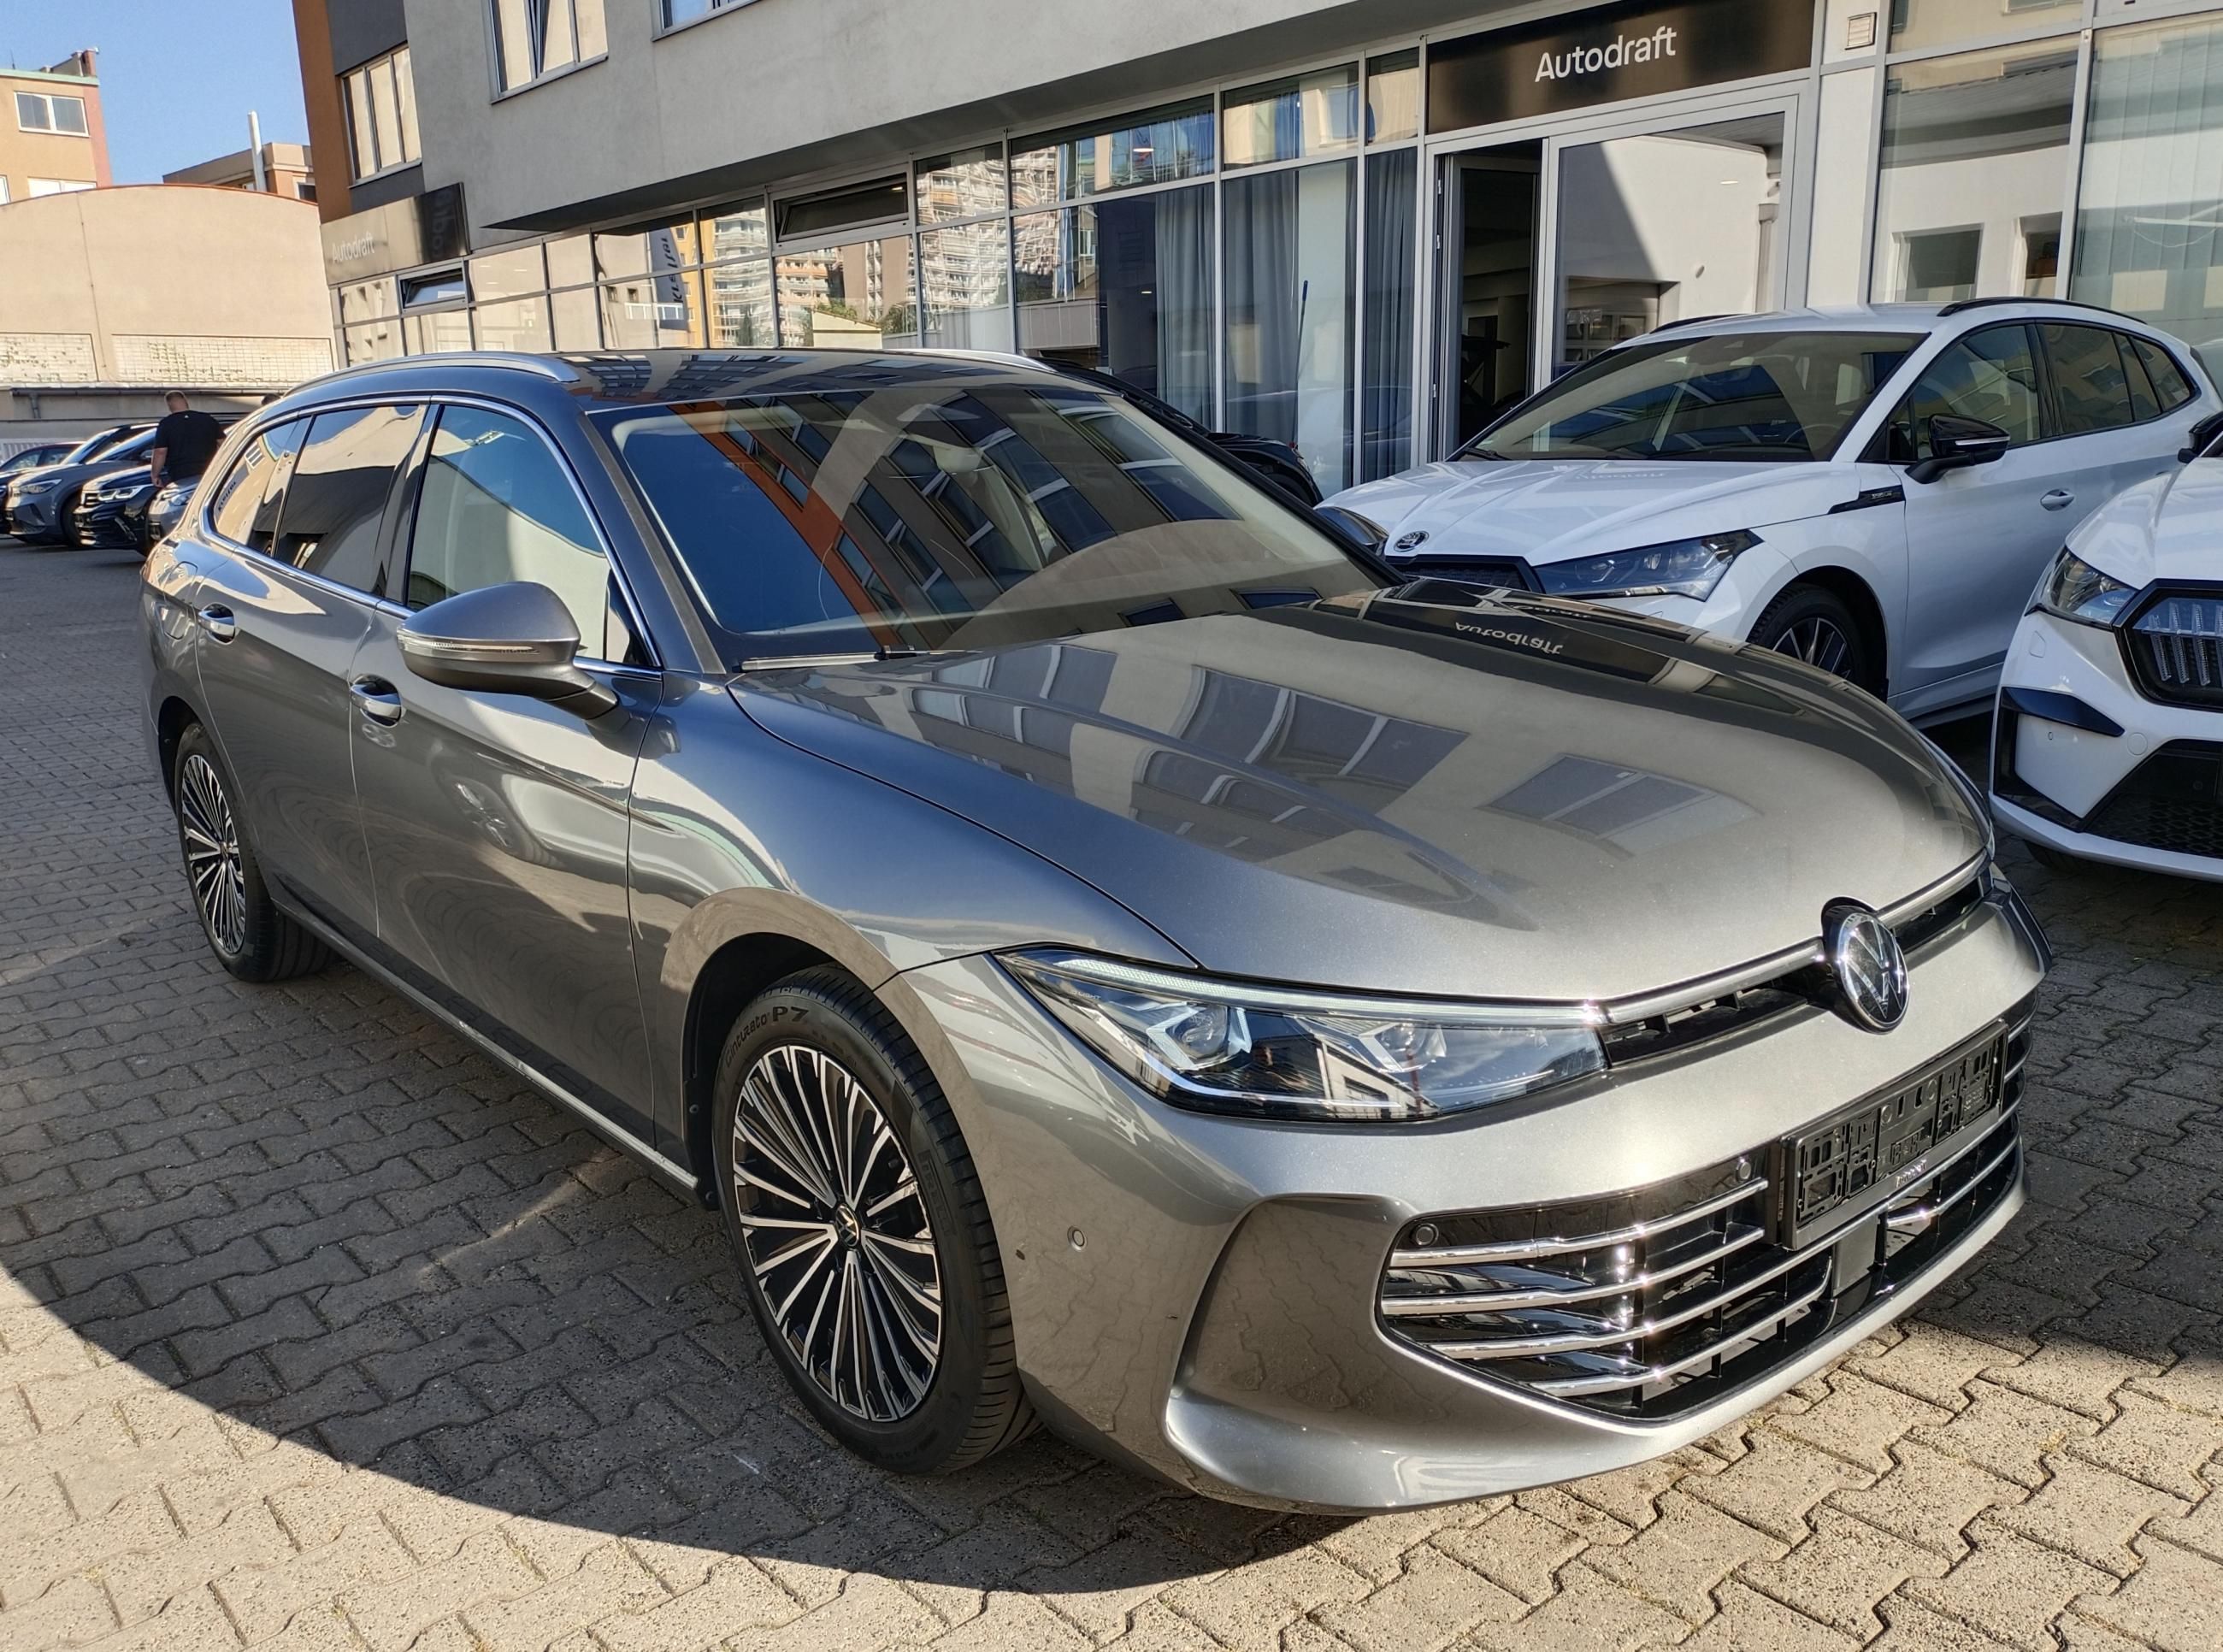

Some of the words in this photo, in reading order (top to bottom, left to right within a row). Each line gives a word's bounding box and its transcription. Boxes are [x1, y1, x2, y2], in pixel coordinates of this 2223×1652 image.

[1535, 26, 1678, 83] Autodraft
[332, 232, 375, 265] Autodraft
[726, 1013, 768, 1068] Cinturato
[772, 1006, 810, 1023] P7
